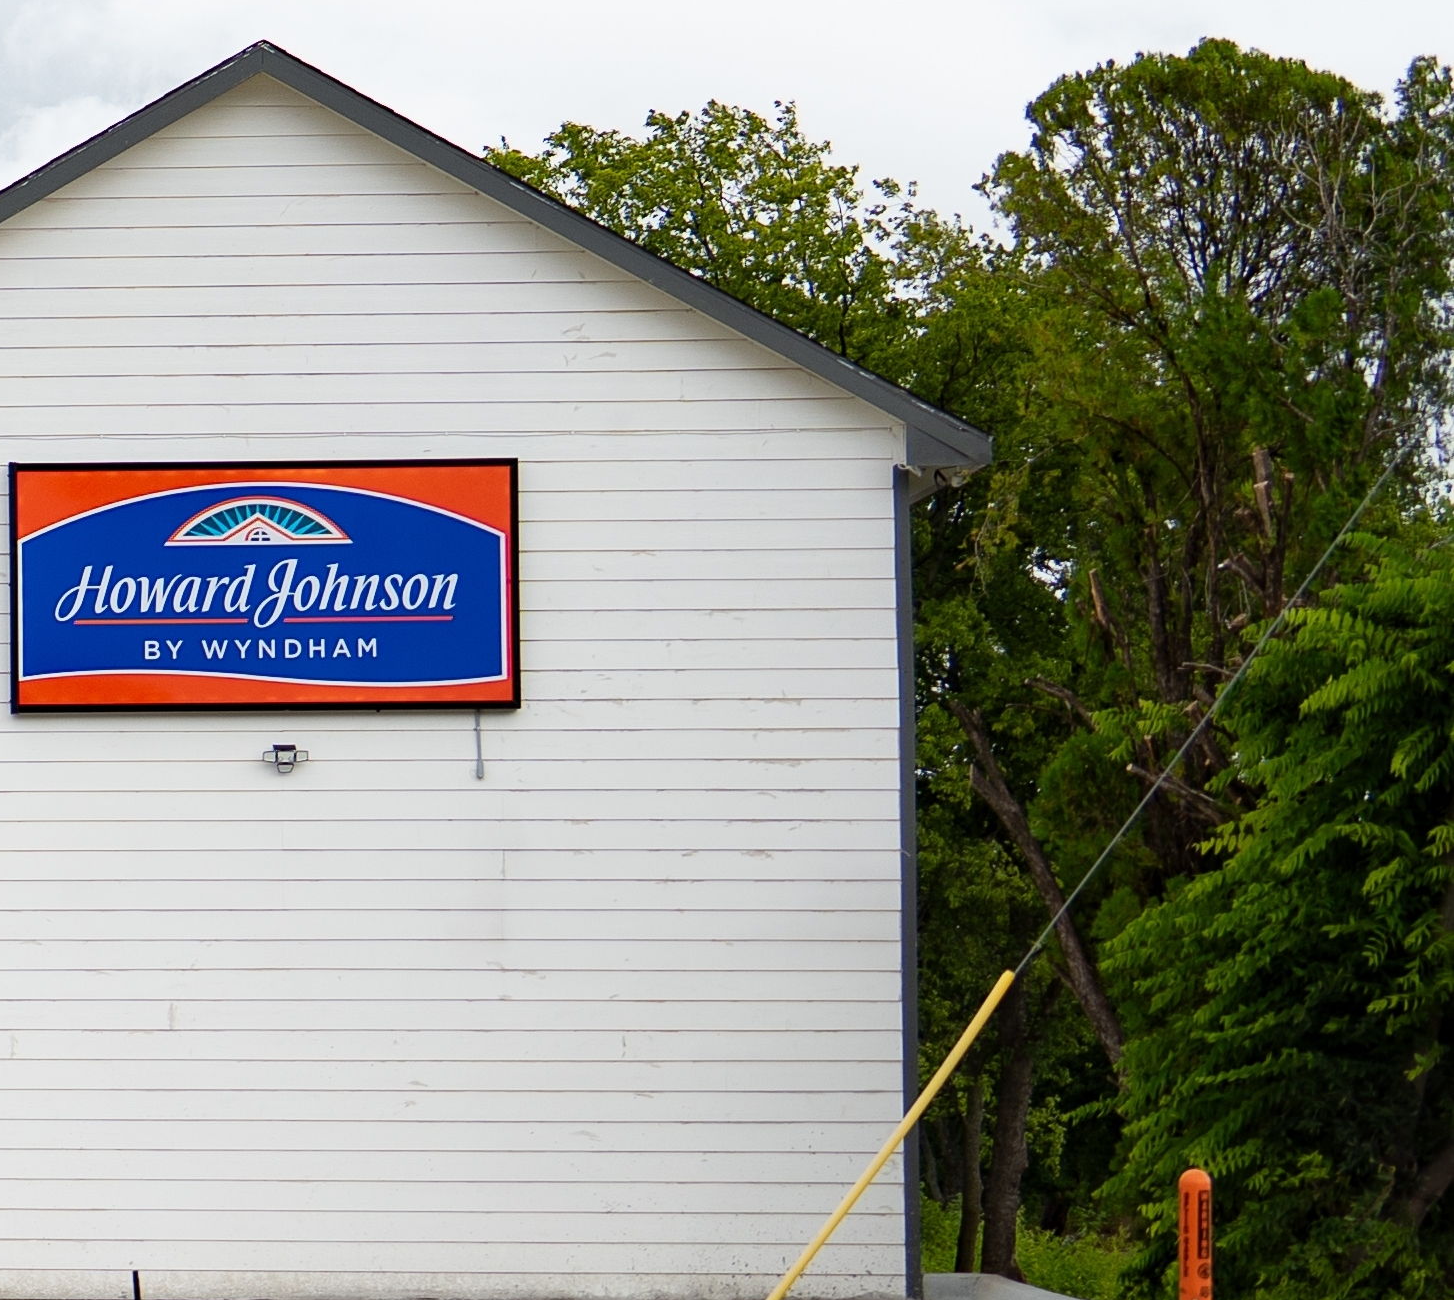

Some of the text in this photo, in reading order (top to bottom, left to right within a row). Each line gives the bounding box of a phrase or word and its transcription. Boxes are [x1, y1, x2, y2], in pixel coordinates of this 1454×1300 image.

[54, 558, 459, 628] Howard Johnson
[144, 638, 379, 660] BY WYNDHAM
